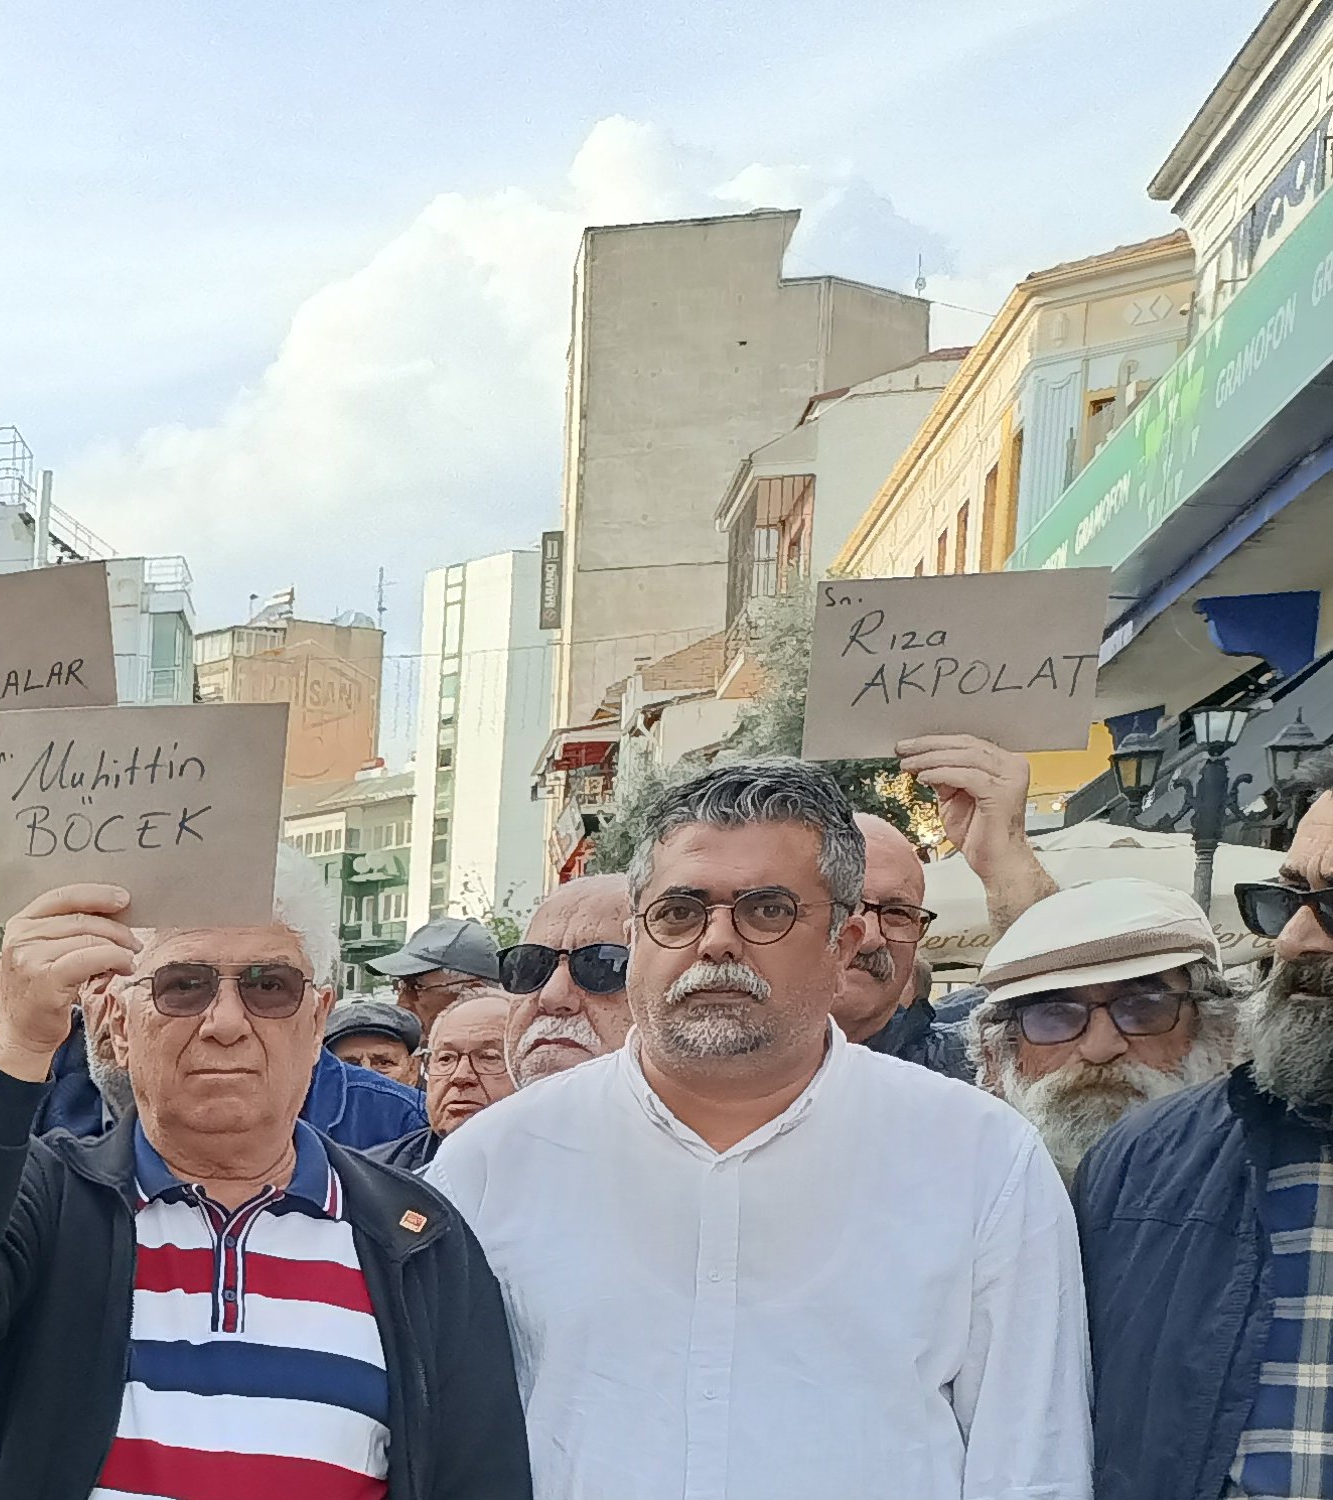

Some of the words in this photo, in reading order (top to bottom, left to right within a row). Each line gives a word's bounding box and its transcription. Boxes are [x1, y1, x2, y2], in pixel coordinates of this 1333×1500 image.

[1215, 292, 1297, 409] GRAMOFON
[824, 587, 863, 608] Sn.
[851, 653, 1100, 707] AKPOLAT
[11, 740, 205, 801] Muhittin
[15, 796, 212, 858] BÖCEK
